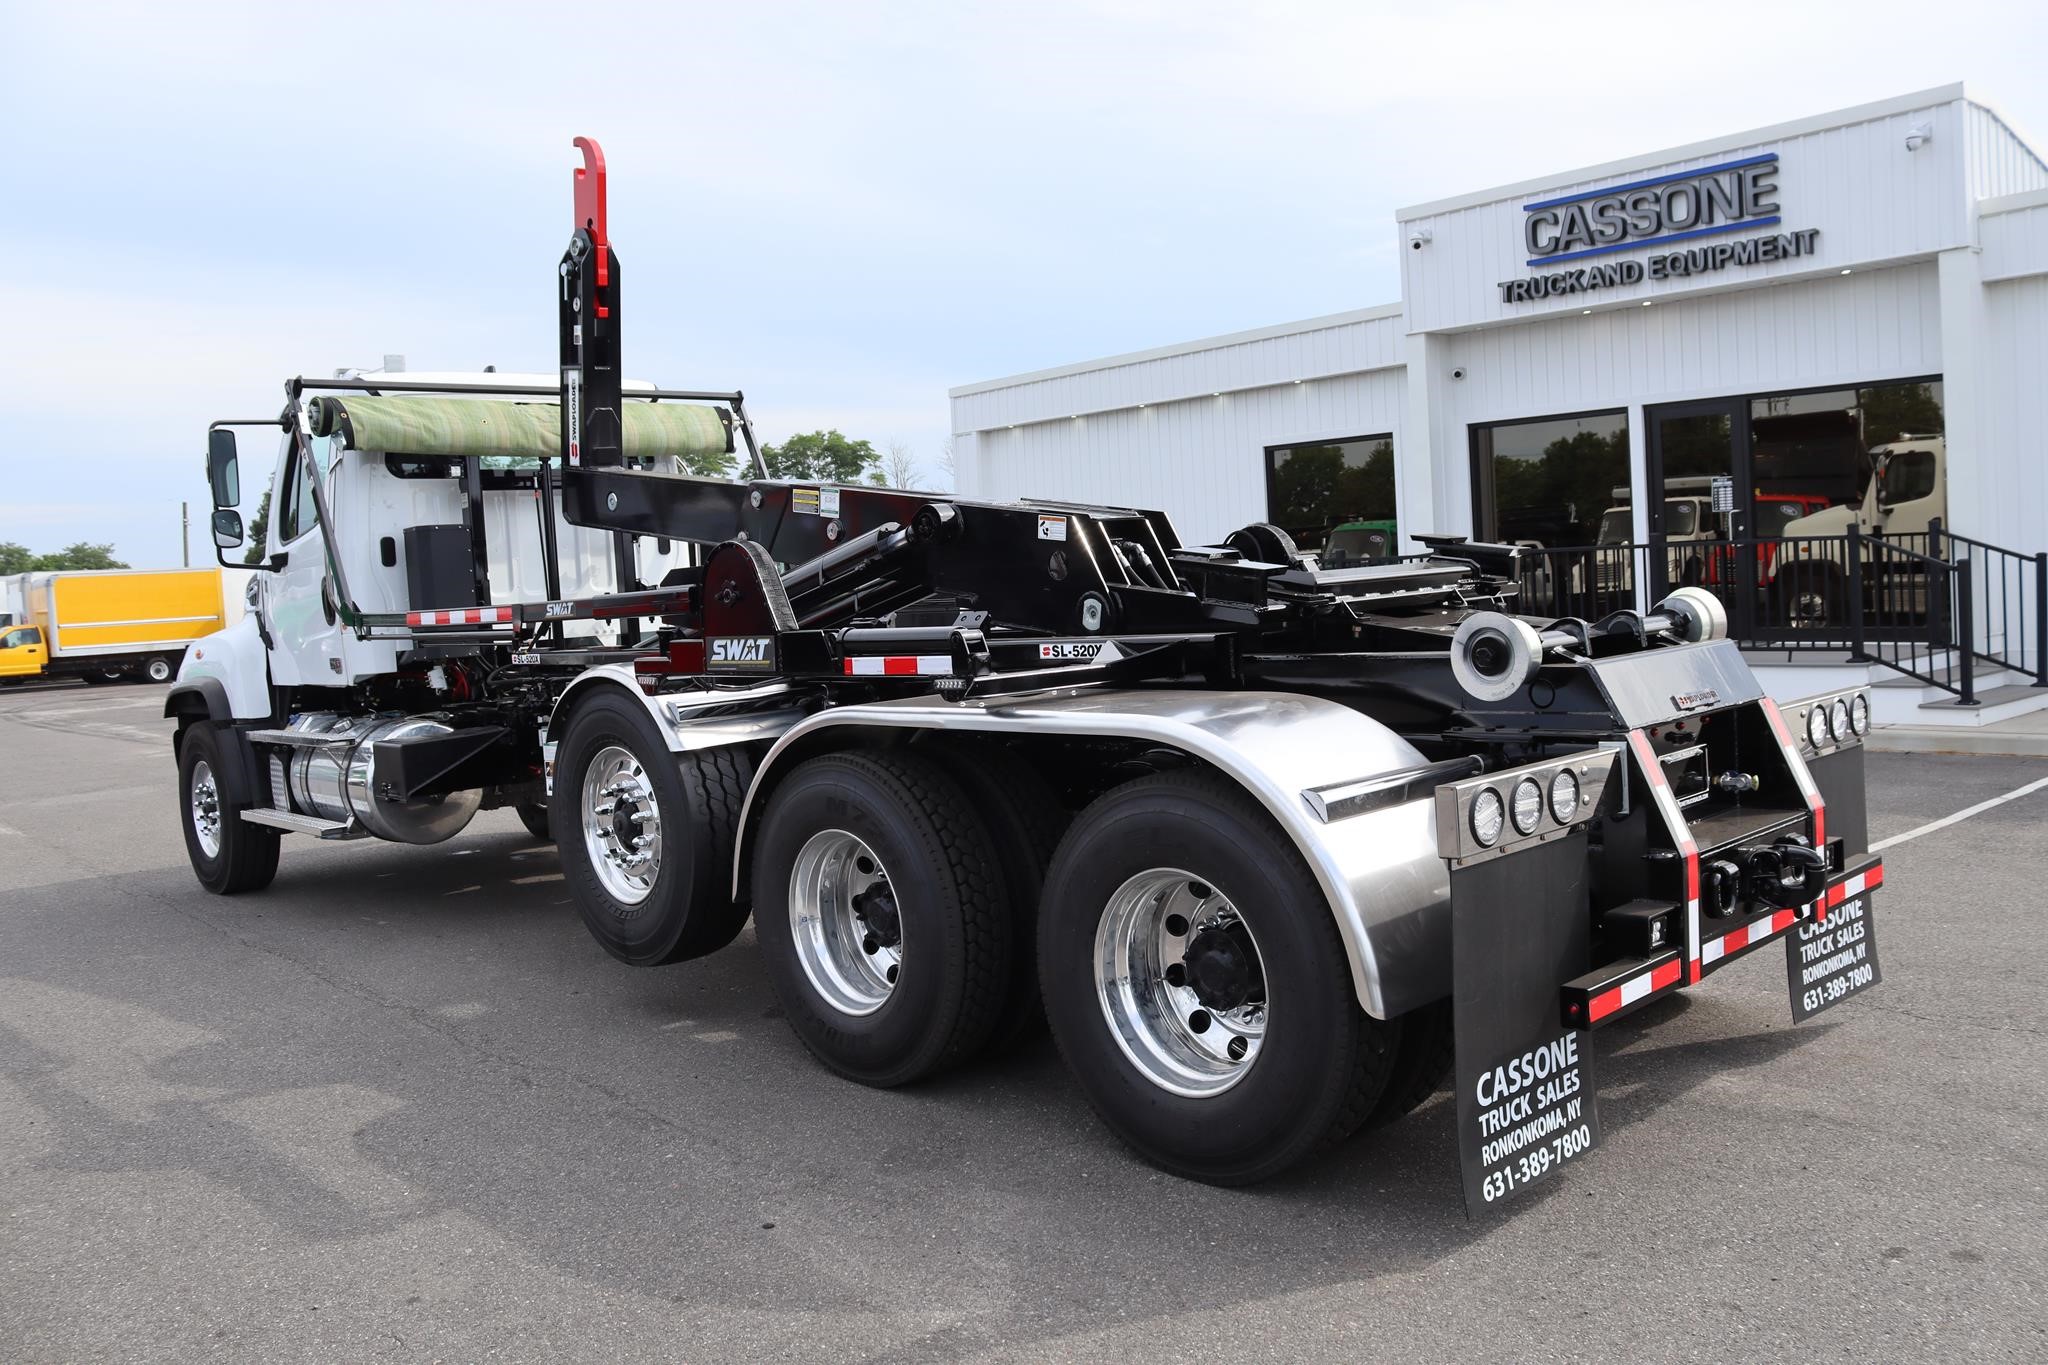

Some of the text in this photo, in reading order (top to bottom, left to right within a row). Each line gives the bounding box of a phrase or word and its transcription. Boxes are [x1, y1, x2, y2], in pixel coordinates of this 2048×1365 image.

[1525, 164, 1780, 255] CASSONE
[1648, 228, 1819, 280] EQUIPMENT
[546, 602, 574, 616] SWAT
[711, 639, 770, 661] SWAT
[1800, 920, 1865, 963] TRUCK SALES
[1802, 942, 1866, 985] RONKONKOMA, NY
[1803, 963, 1873, 1012] 631-389-7800
[1476, 1031, 1579, 1107] CASSONE
[1478, 1068, 1581, 1138] TRUCK SALES
[1482, 1096, 1582, 1167] RONKONKOMA, NY
[1483, 1124, 1591, 1202] 631-389-7800
